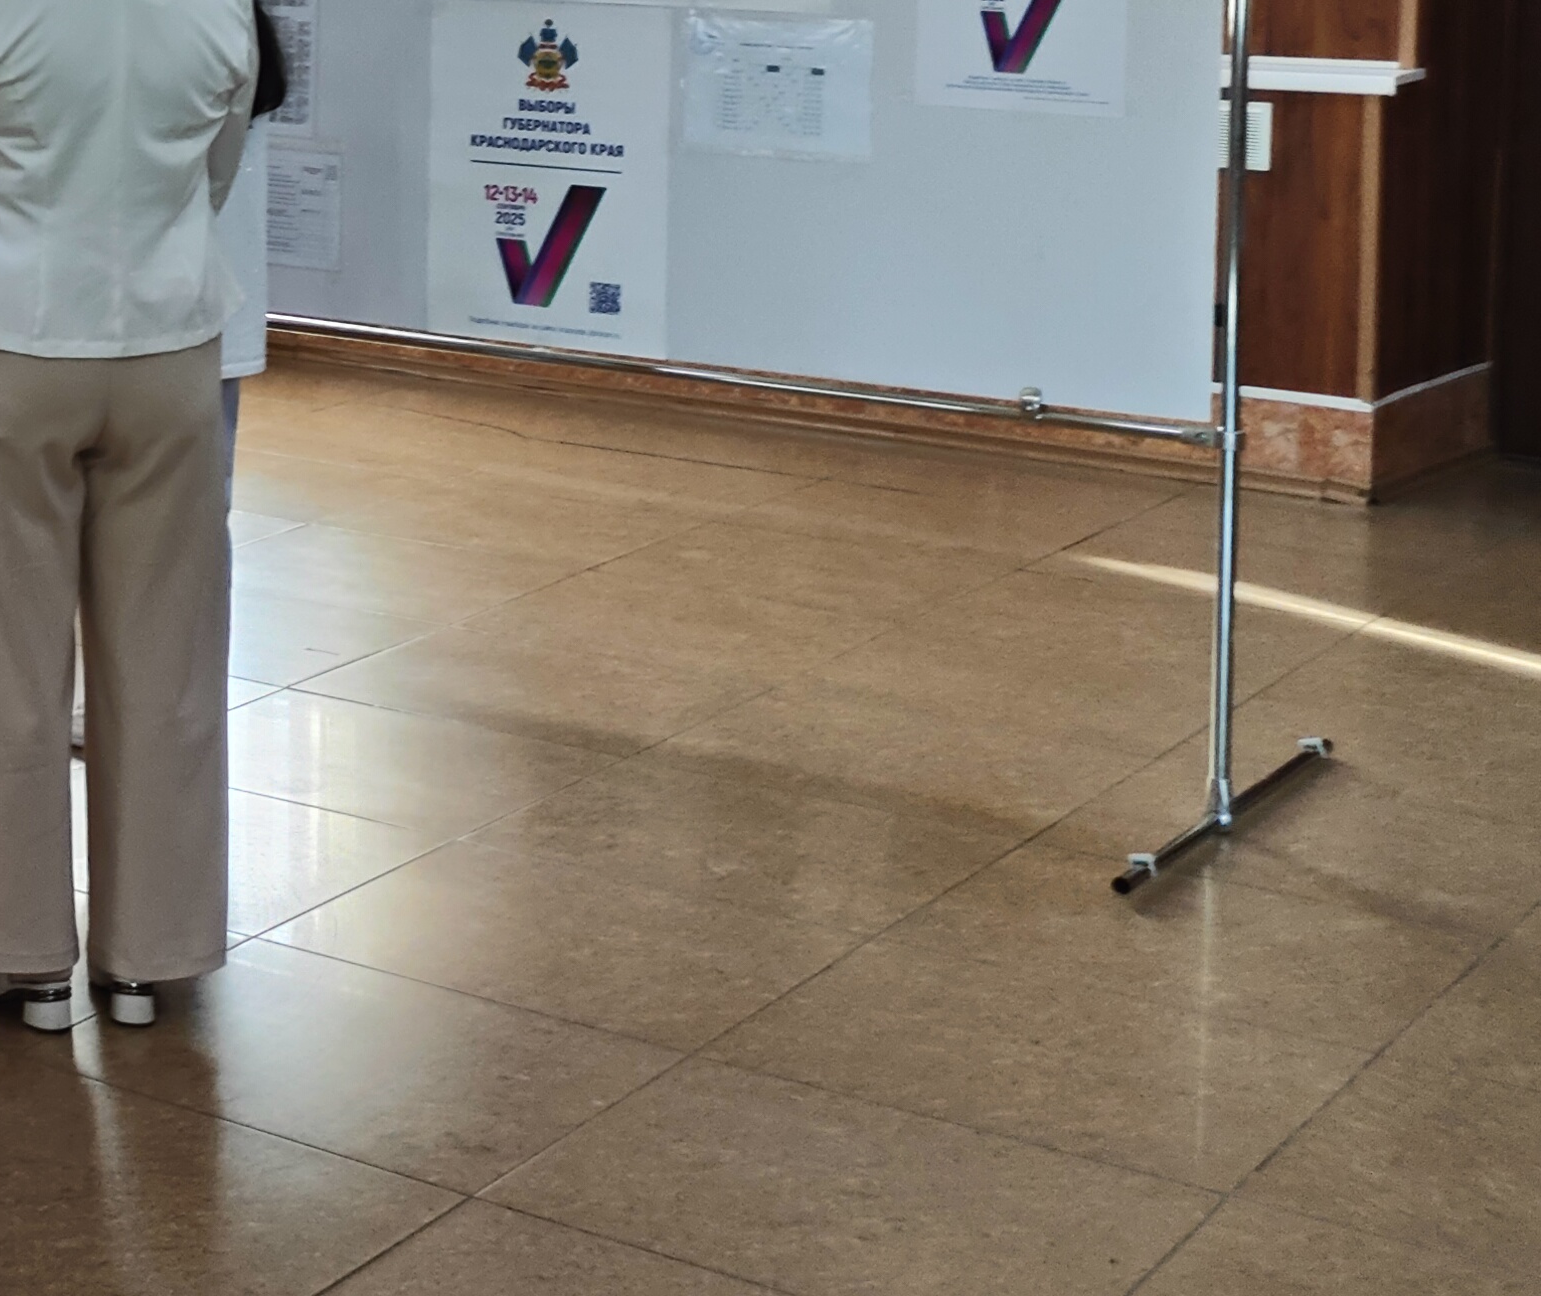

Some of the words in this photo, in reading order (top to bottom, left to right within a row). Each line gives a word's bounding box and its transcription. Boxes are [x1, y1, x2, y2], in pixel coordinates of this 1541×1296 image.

[518, 99, 577, 115] ВЫБОРЫ
[503, 117, 591, 135] ГУБЕРНАТОРА
[470, 134, 587, 154] КРАСНОДАРСКОГО
[590, 143, 624, 157] КРАЯ
[495, 211, 526, 226] 2025
